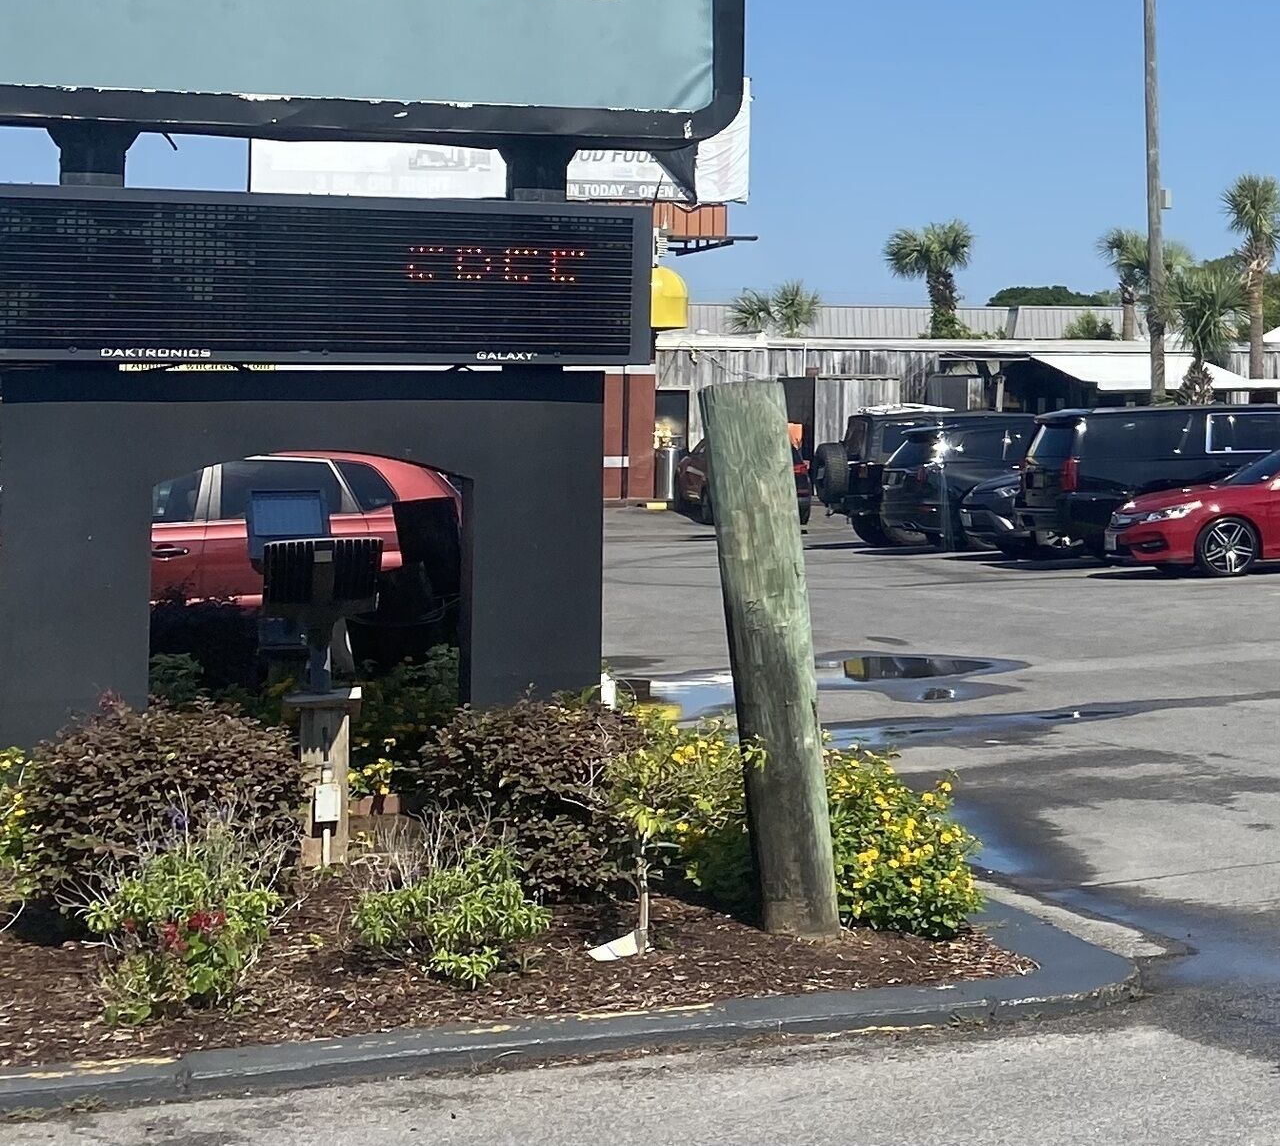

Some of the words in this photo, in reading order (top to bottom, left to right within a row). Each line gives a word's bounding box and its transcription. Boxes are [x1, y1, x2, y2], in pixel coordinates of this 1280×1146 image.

[582, 184, 625, 197] TODAY
[639, 185, 674, 198] OPEN
[100, 348, 211, 358] DAKTRONICS
